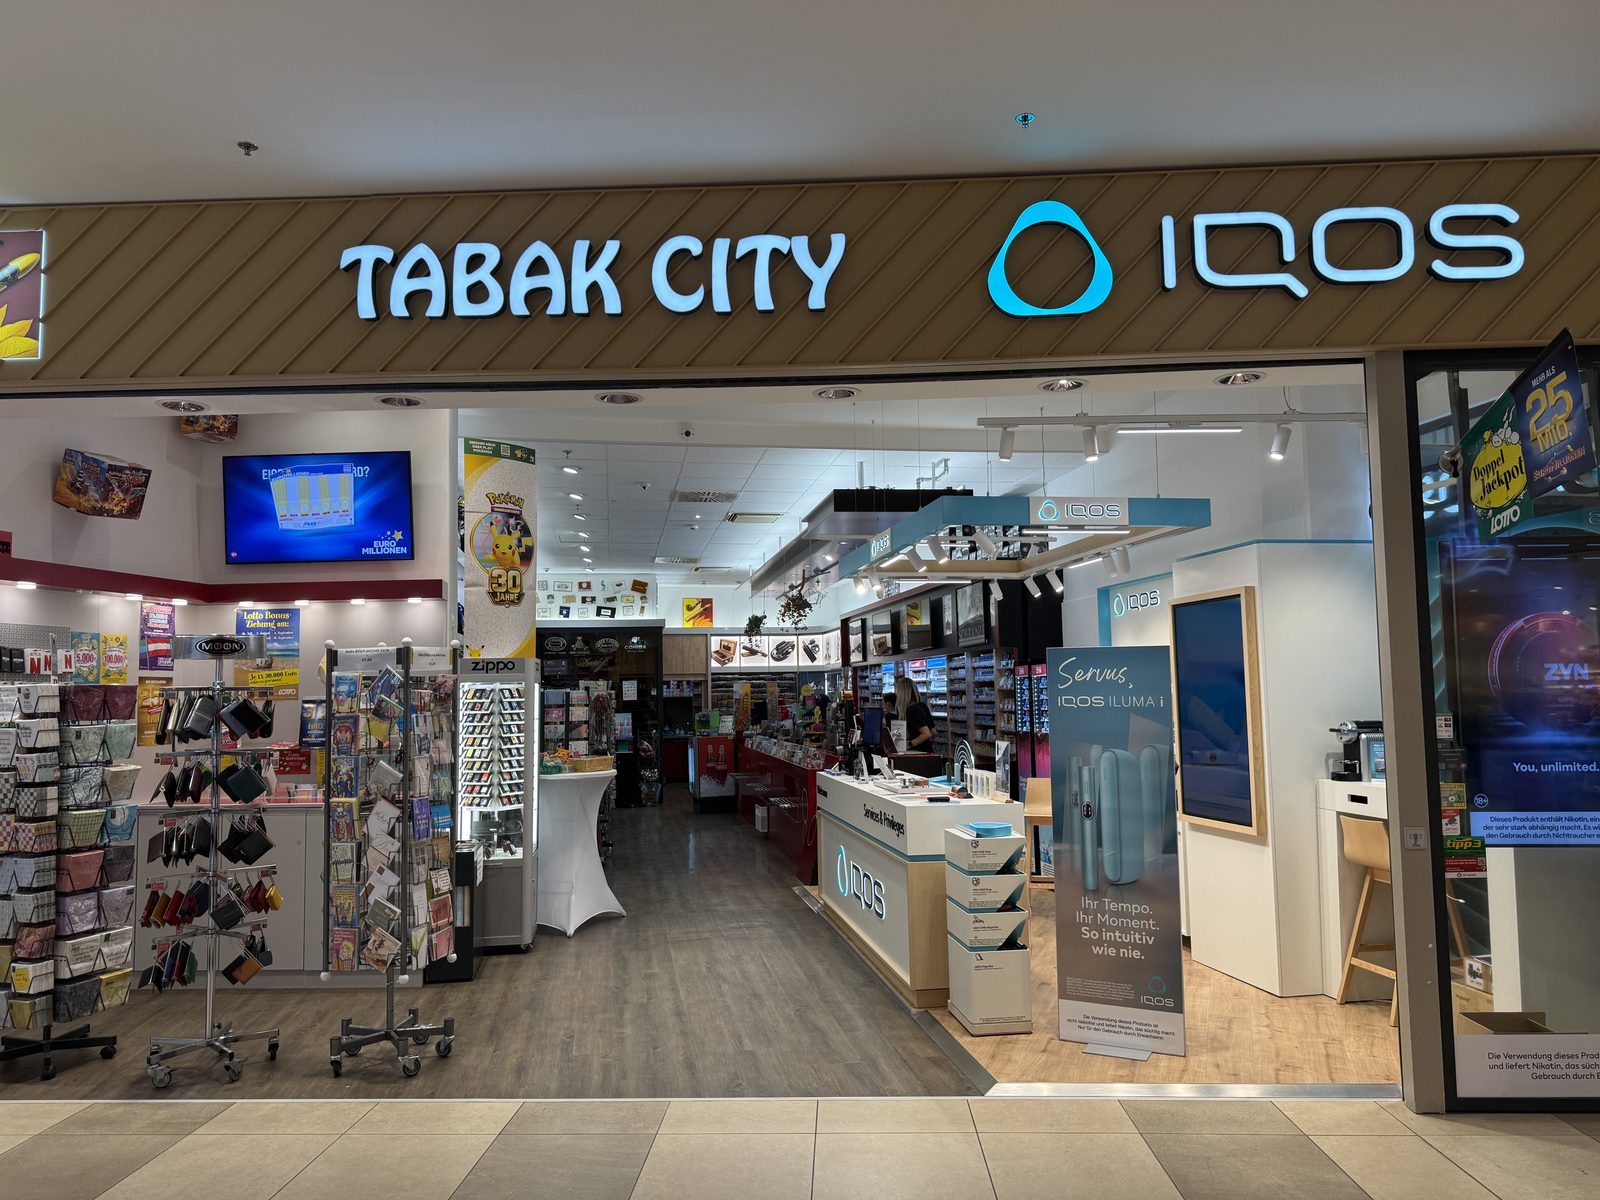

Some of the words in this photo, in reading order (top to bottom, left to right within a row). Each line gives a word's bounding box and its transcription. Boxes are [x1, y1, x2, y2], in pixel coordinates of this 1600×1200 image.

[1162, 203, 1525, 297] IQOS
[340, 240, 622, 320] TABAK
[651, 232, 846, 314] CITY
[1531, 371, 1546, 388] MEHR
[1546, 365, 1556, 379] ALS
[1525, 370, 1574, 441] 25
[1472, 450, 1505, 482] Doppel
[1479, 458, 1525, 501] Jackpot
[1064, 503, 1121, 519] IQOS
[1490, 505, 1521, 534] LOTTO
[362, 546, 407, 555] MILLIONEN
[373, 540, 397, 548] EURO
[490, 568, 521, 592] 30
[494, 592, 519, 602] JAHRE
[1127, 589, 1160, 612] IQOS
[243, 611, 264, 620] Lotto
[201, 642, 240, 651] MOON
[1058, 657, 1134, 689] Servus,
[1543, 663, 1589, 681] ZYN
[1058, 696, 1105, 708] IQOS
[1109, 696, 1156, 707] ILUMA
[1160, 696, 1164, 707] i
[1513, 762, 1538, 773] You,
[1541, 762, 1599, 772] unlimited.
[863, 803, 880, 824] Services
[883, 812, 905, 837] Privileges
[1528, 824, 1559, 832] abhängig
[1564, 816, 1589, 824] Nikotin,
[850, 860, 885, 920] IQOS
[1081, 897, 1099, 910] Ihr
[1103, 898, 1153, 917] Tempo.
[1076, 912, 1093, 924] Ihr
[1097, 913, 1160, 930] Moment.
[1081, 927, 1099, 940] So
[1102, 928, 1155, 945] intuitiv
[1092, 944, 1116, 956] wie
[1119, 946, 1145, 960] nie.
[1140, 995, 1175, 1007] IQOS
[1091, 1015, 1117, 1024] Verwendung
[1133, 1020, 1152, 1028] Produkts
[1144, 1027, 1160, 1035] süchtig
[1487, 1052, 1501, 1060] Die
[1503, 1052, 1553, 1061] Verwendung
[1554, 1052, 1579, 1060] dieses
[1505, 1062, 1530, 1070] liefert
[1532, 1062, 1563, 1071] Nikotin,
[1565, 1062, 1580, 1070] das
[1531, 1072, 1571, 1080] Gebrauch
[1572, 1072, 1595, 1080] durch
